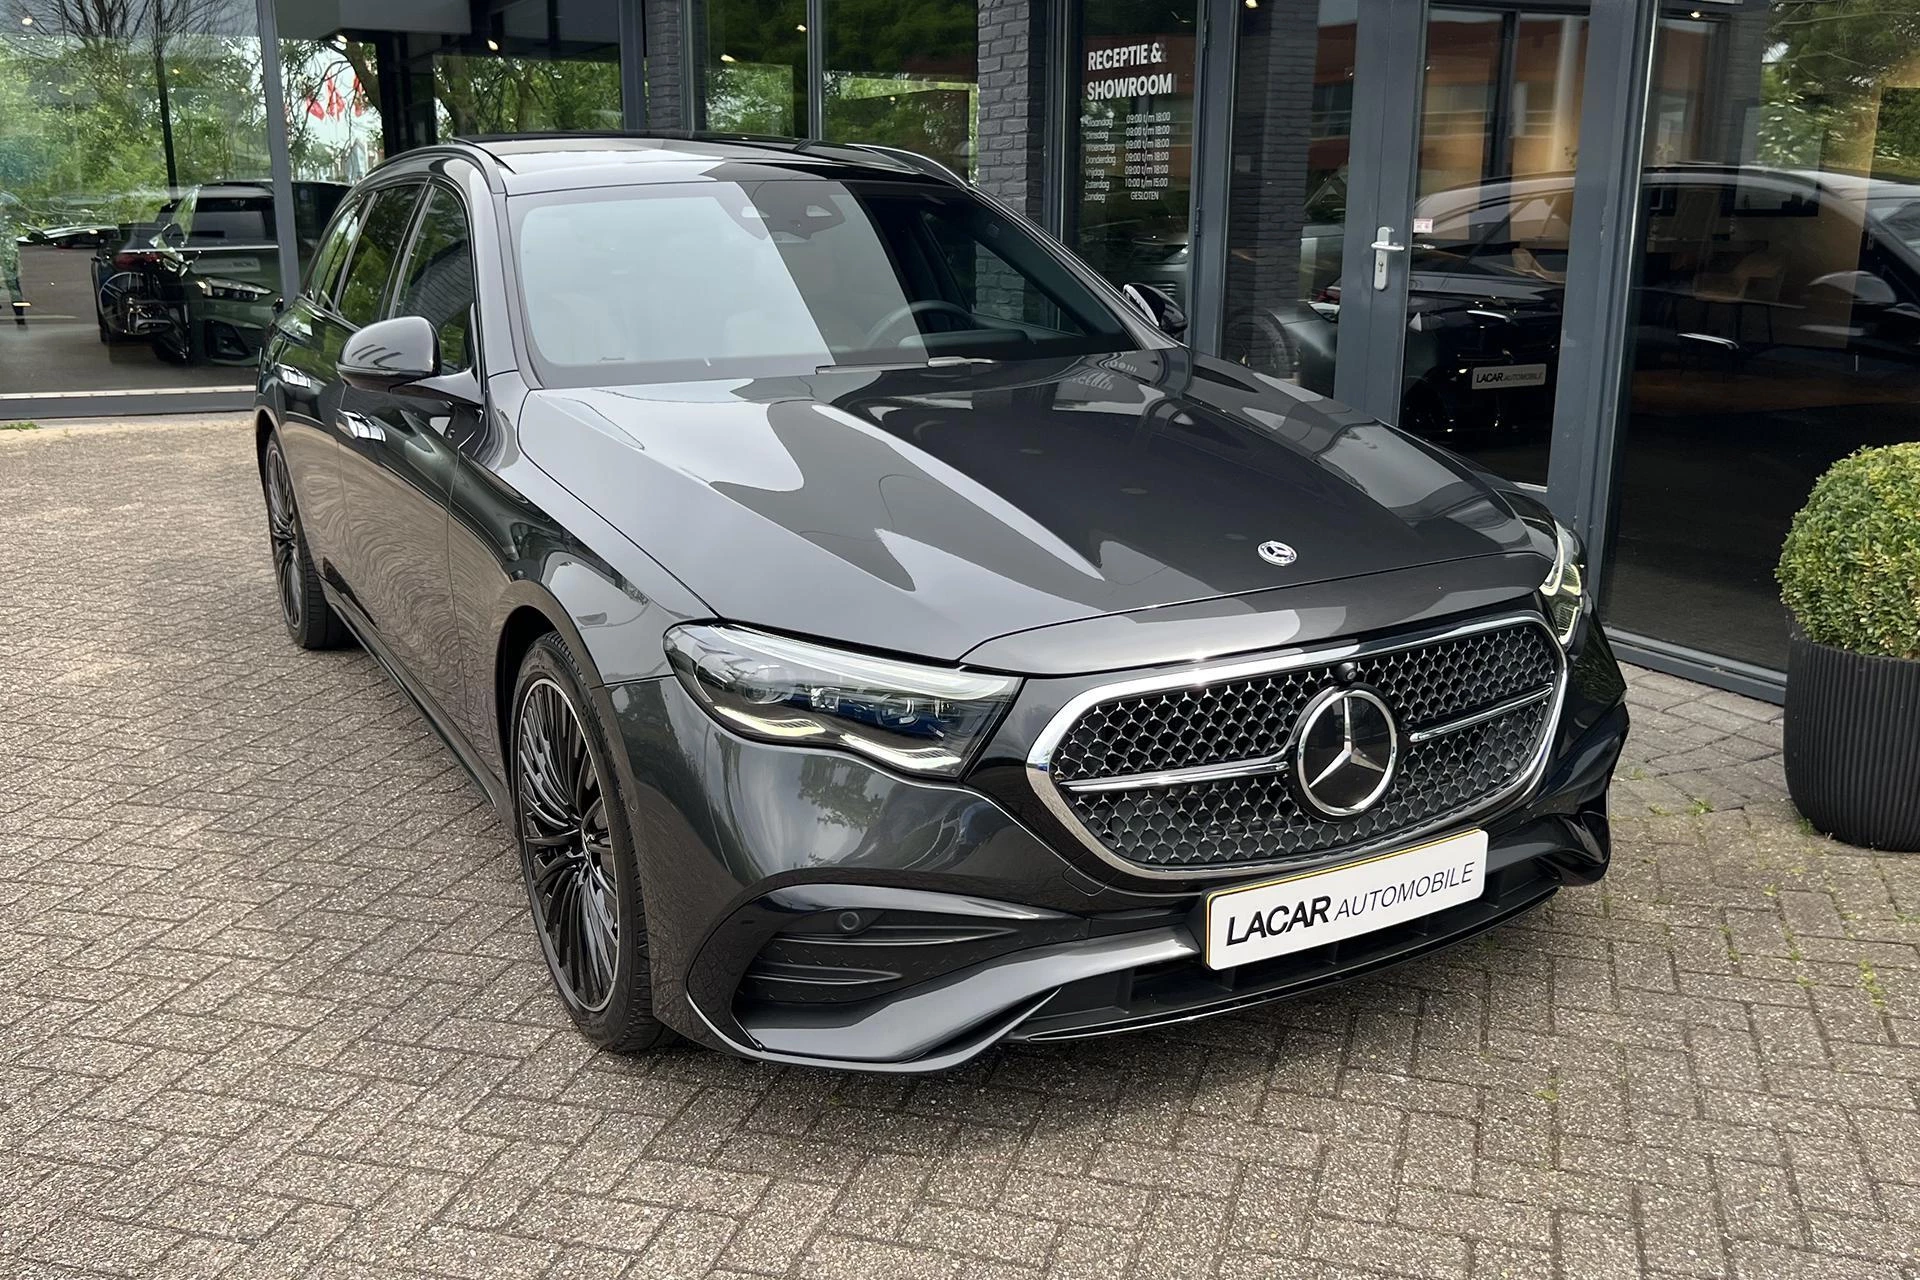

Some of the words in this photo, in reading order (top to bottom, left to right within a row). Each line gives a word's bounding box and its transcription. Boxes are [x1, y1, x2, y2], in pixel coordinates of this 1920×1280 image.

[1088, 44, 1148, 71] RECEPTIE
[1151, 42, 1162, 63] &
[1087, 73, 1172, 101] SHOWROOM
[1130, 191, 1159, 200] GESLOTEN
[1476, 372, 1503, 383] LACAR
[1226, 895, 1331, 946] LACAR
[1334, 862, 1475, 921] AUTOMOBILE
